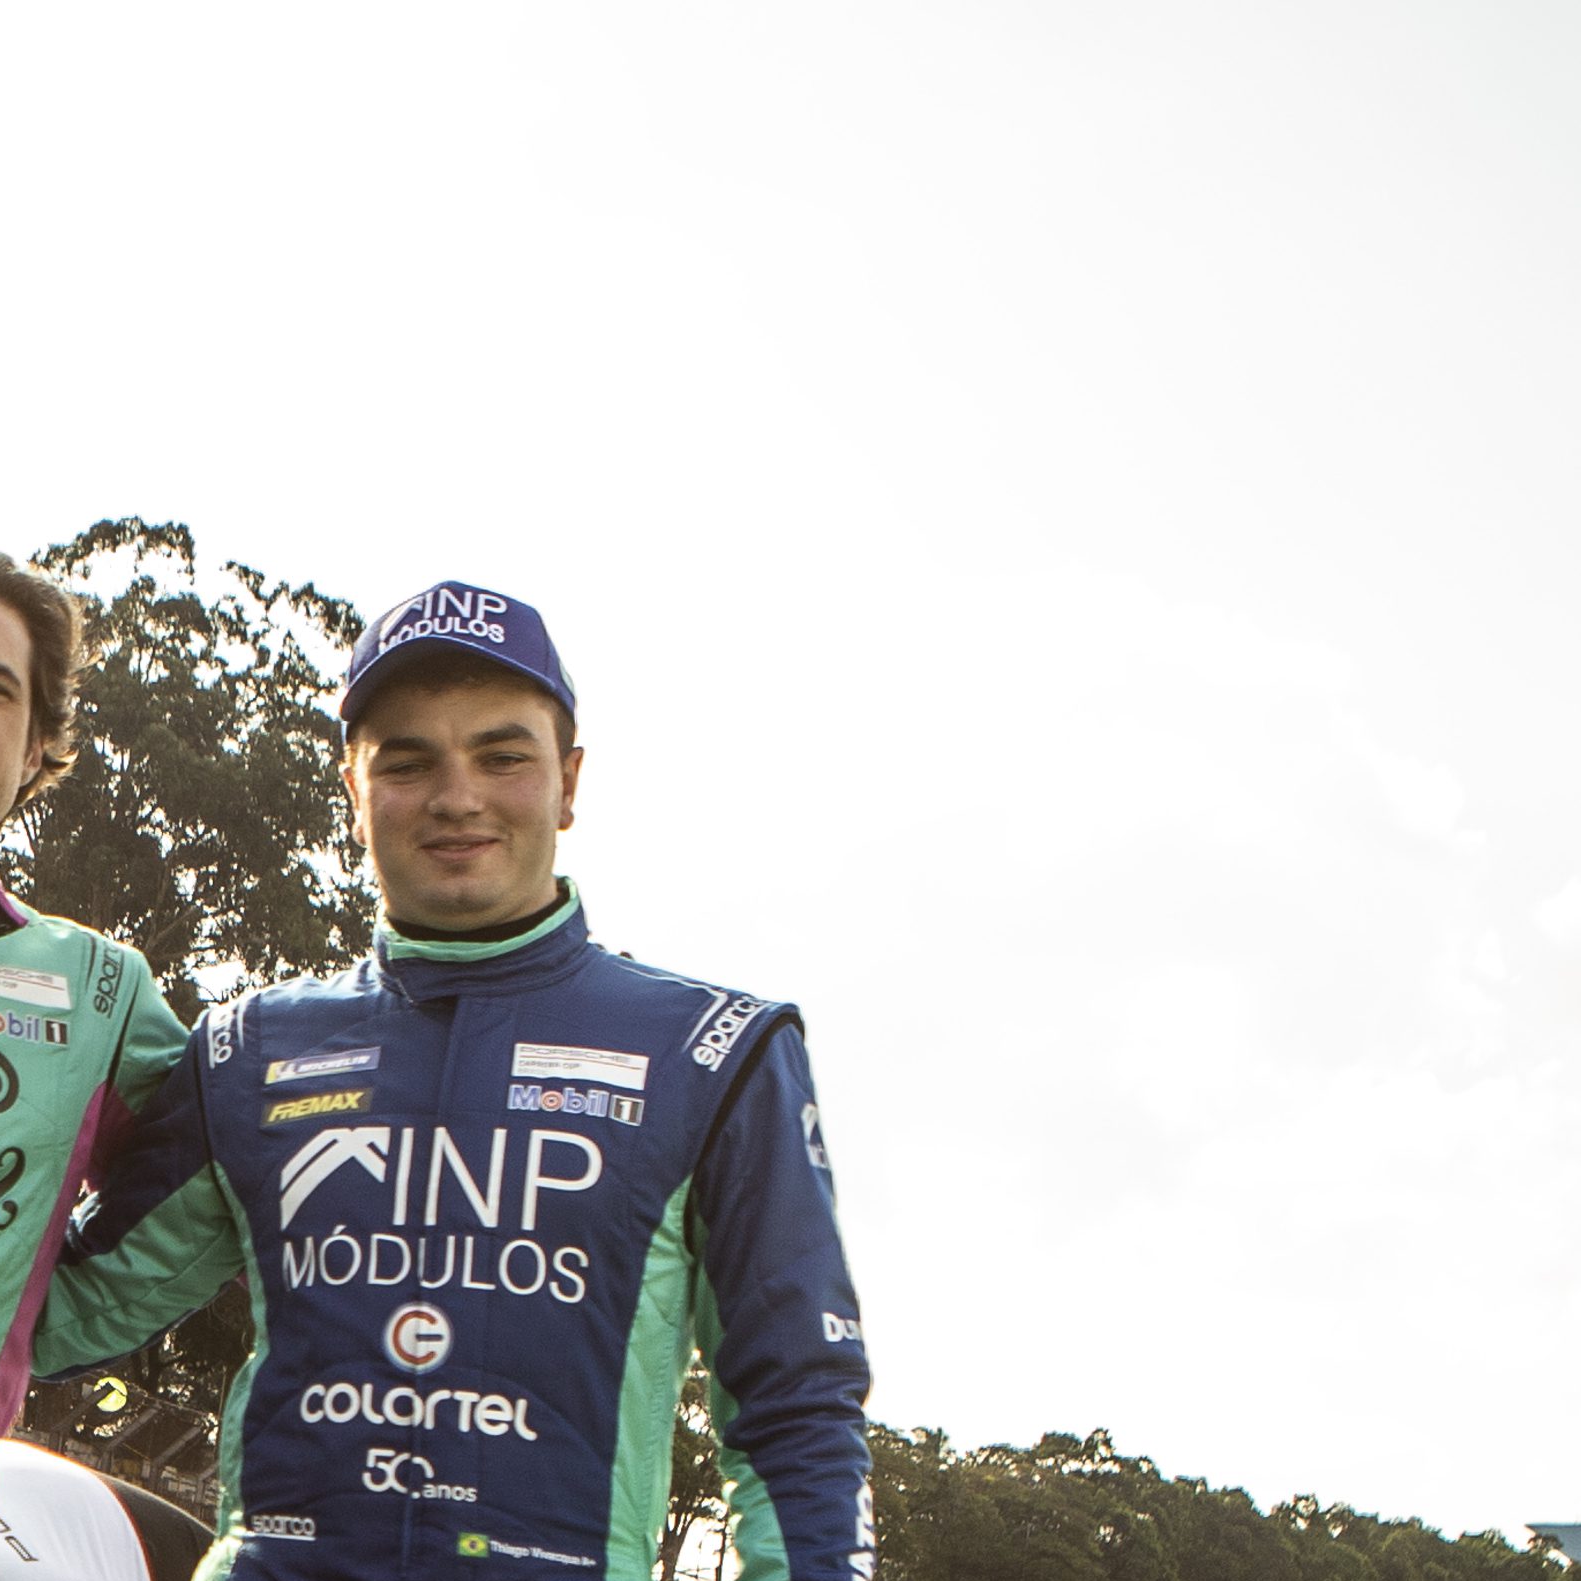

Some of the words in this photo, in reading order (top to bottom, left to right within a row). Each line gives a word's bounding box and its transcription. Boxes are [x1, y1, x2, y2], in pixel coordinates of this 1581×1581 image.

[423, 587, 507, 620] INP
[268, 1091, 365, 1123] FREMAX
[507, 1084, 610, 1119] Mobil
[393, 1126, 603, 1232] INP
[282, 1226, 590, 1303] MÓDULOS
[251, 1515, 316, 1541] sparco
